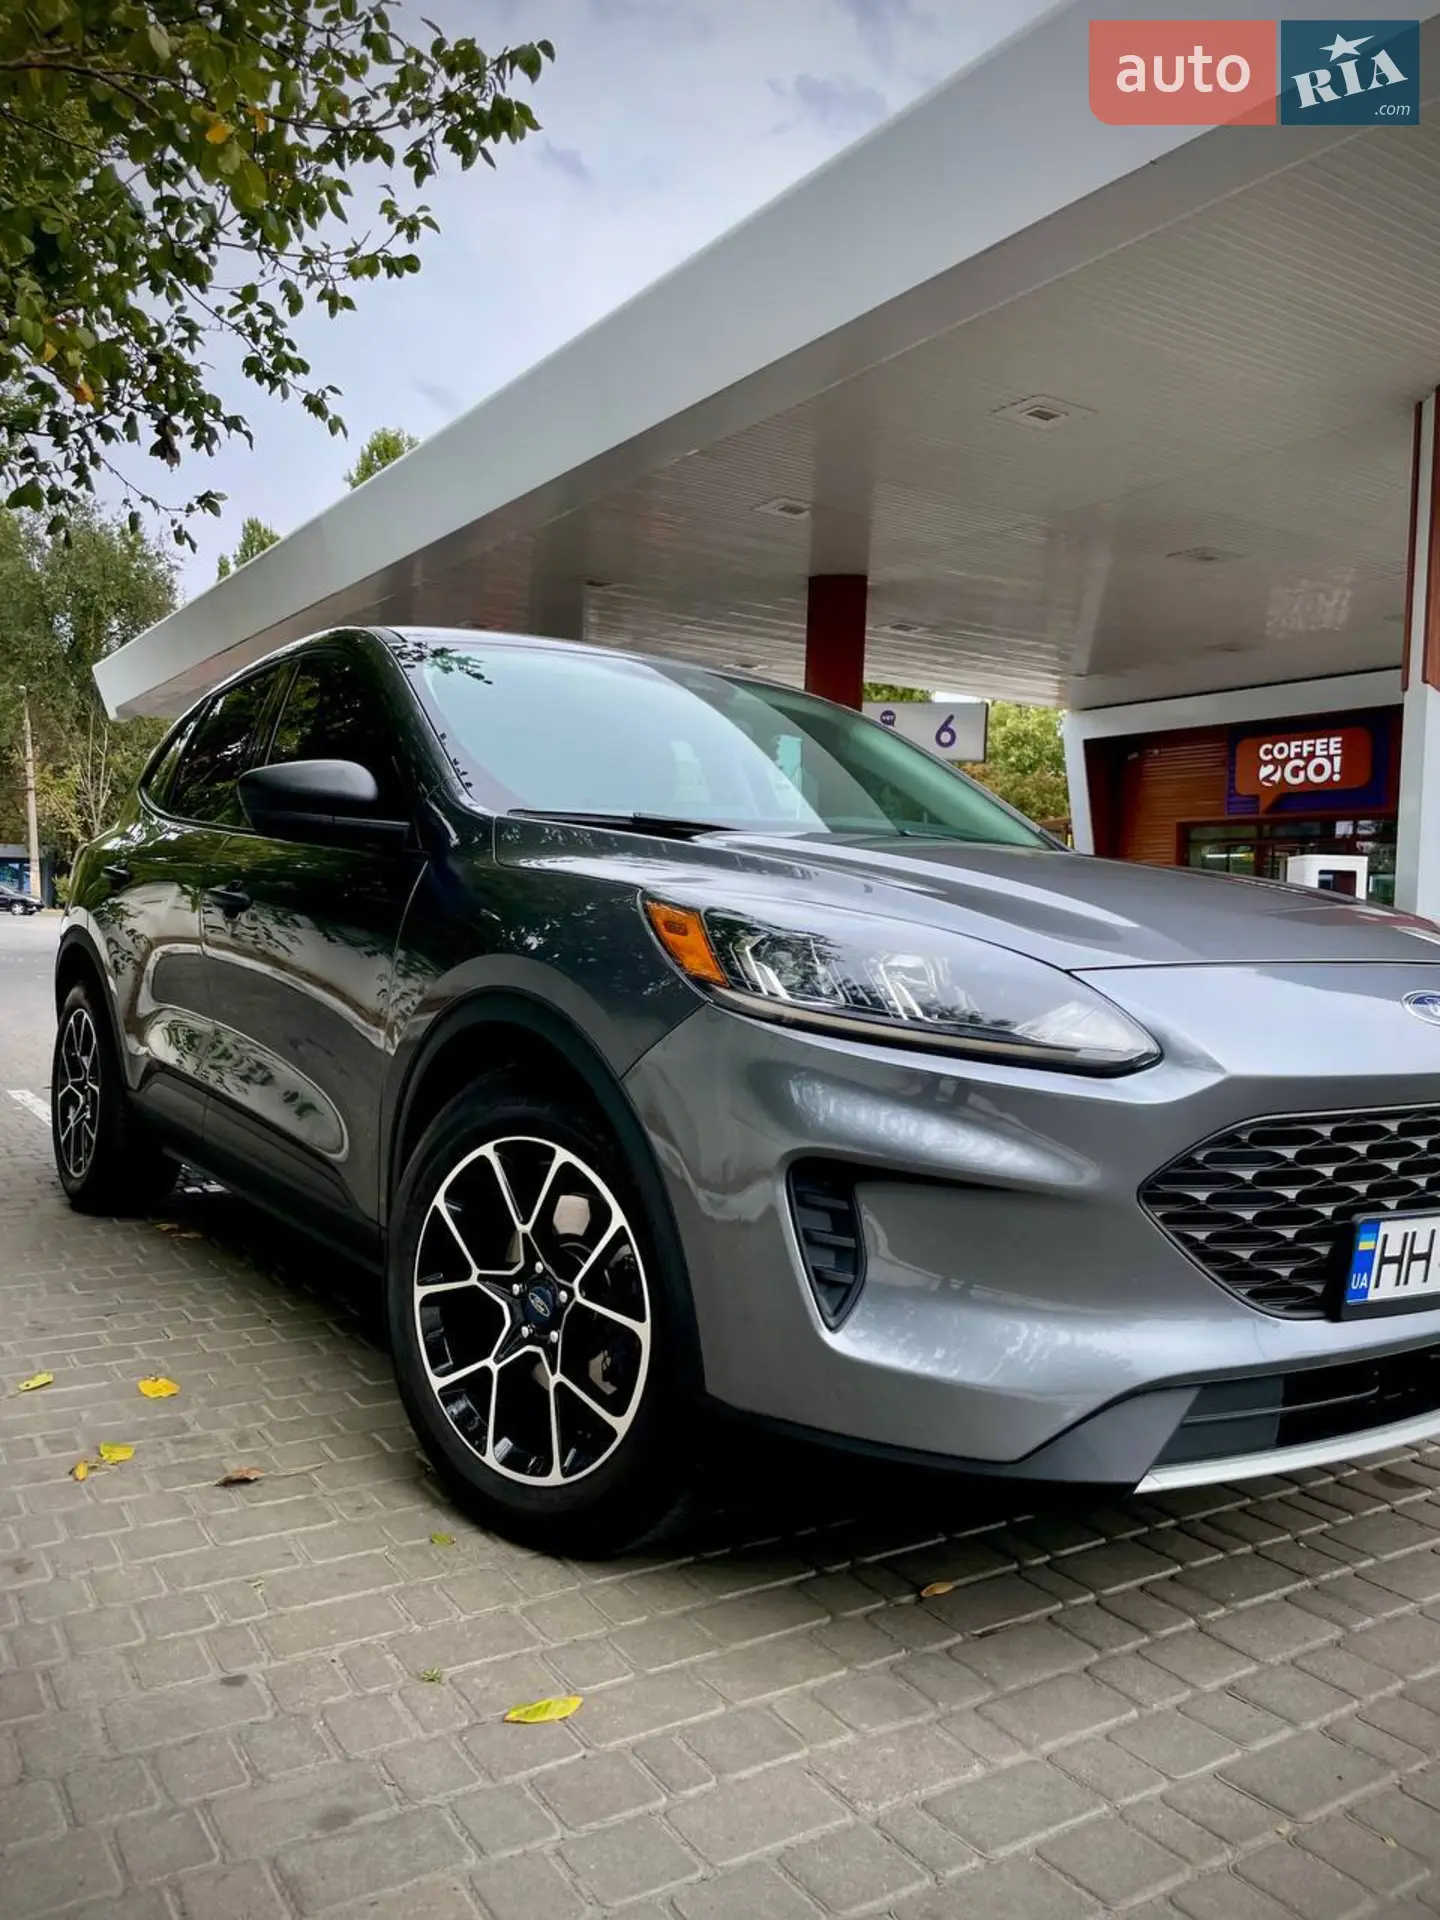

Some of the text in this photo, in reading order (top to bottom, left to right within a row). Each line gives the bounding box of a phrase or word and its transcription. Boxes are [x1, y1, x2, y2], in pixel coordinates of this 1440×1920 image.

[935, 714, 957, 749] 6
[1258, 736, 1343, 761] COFFEE
[1374, 1228, 1437, 1289] HH
[1351, 1272, 1369, 1290] UA
